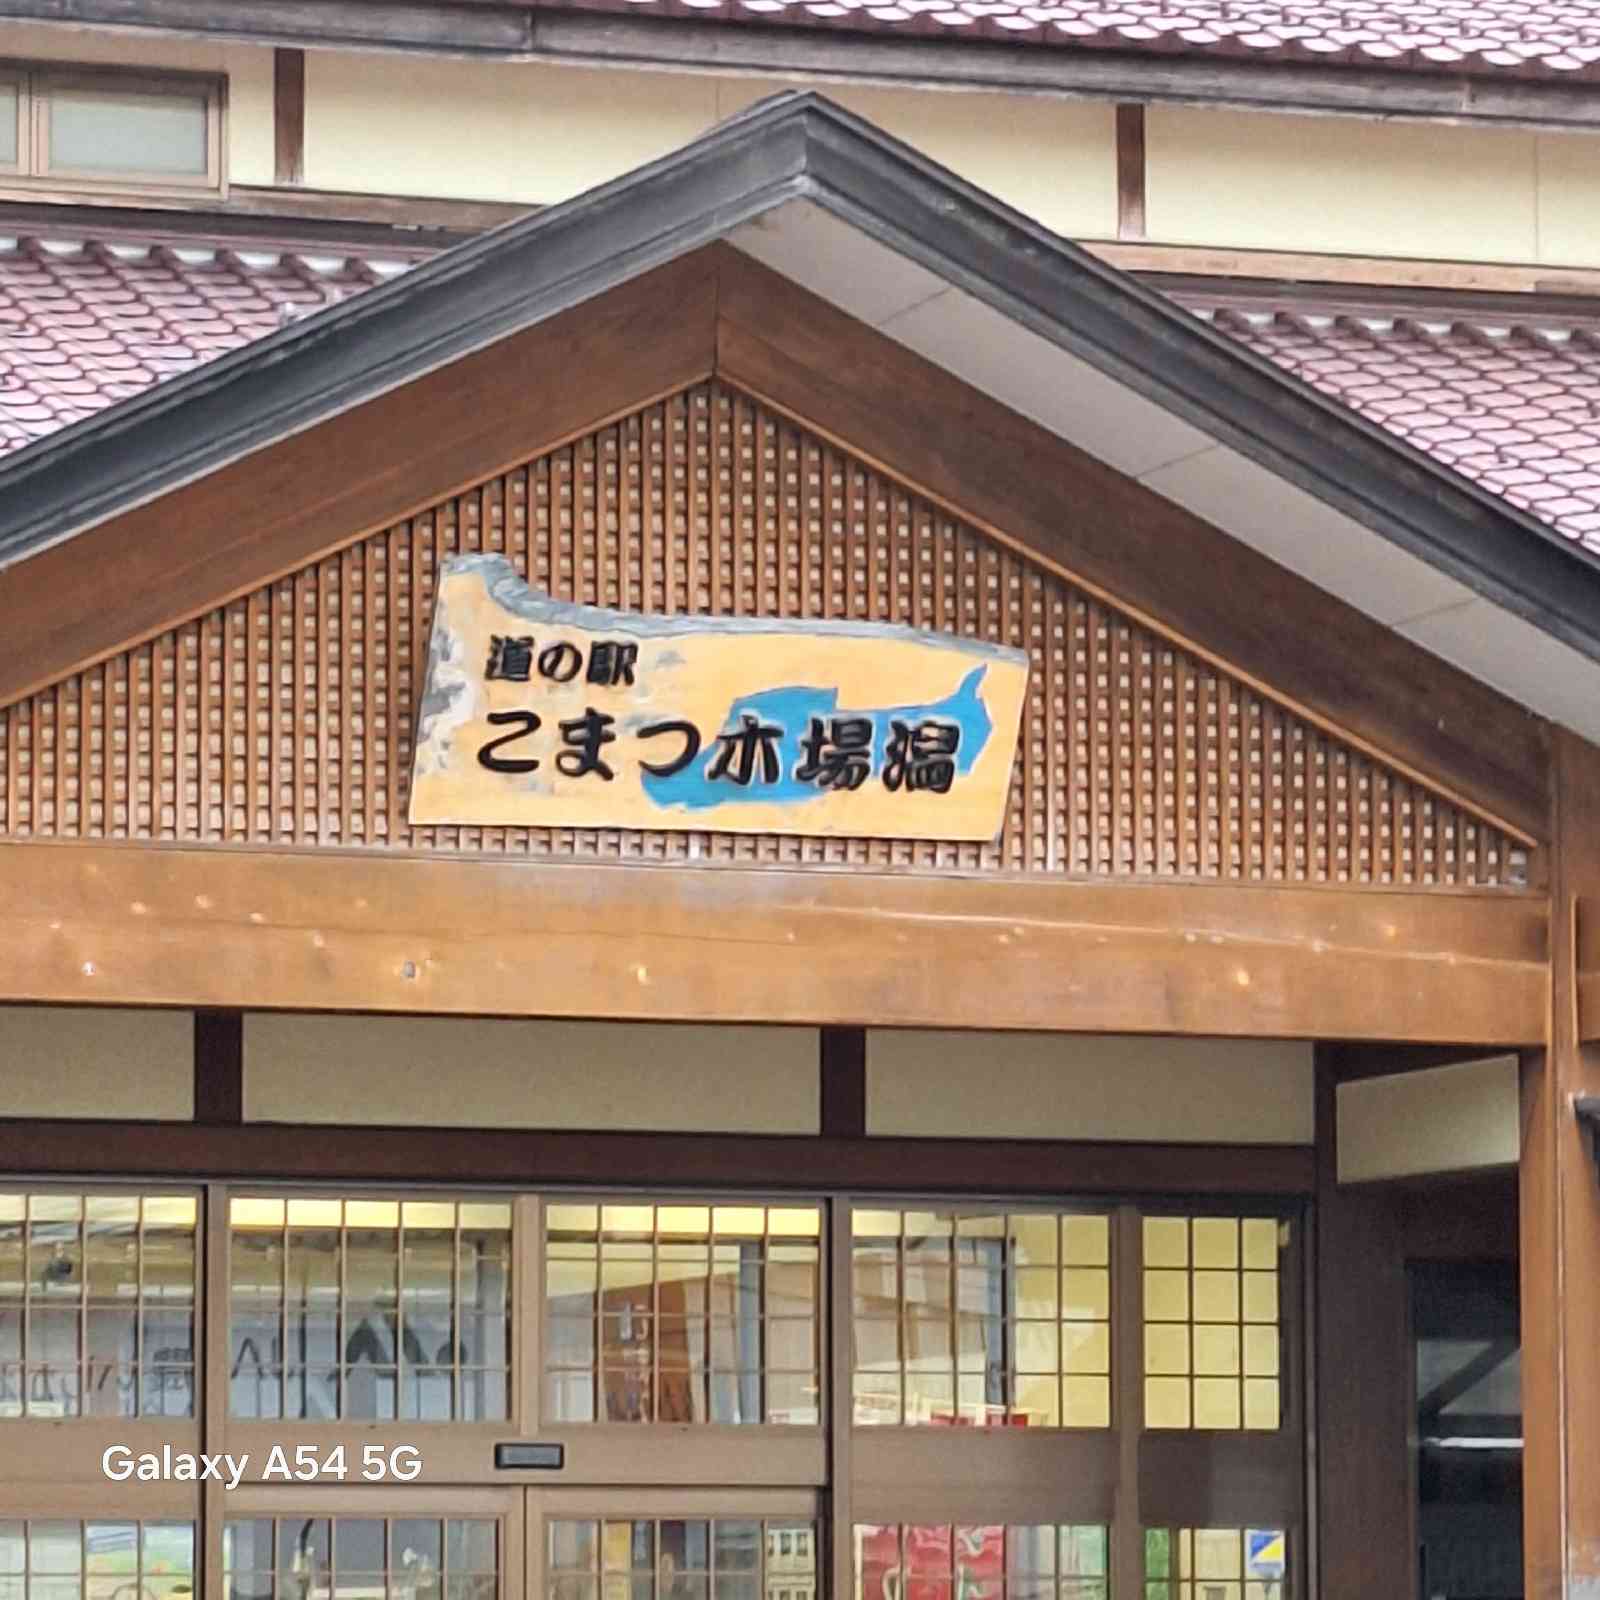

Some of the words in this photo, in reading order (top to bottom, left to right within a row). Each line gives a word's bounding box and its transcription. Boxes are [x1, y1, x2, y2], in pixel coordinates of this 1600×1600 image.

[484, 634, 639, 686] 道の駅
[477, 706, 961, 795] こまつ木場潟
